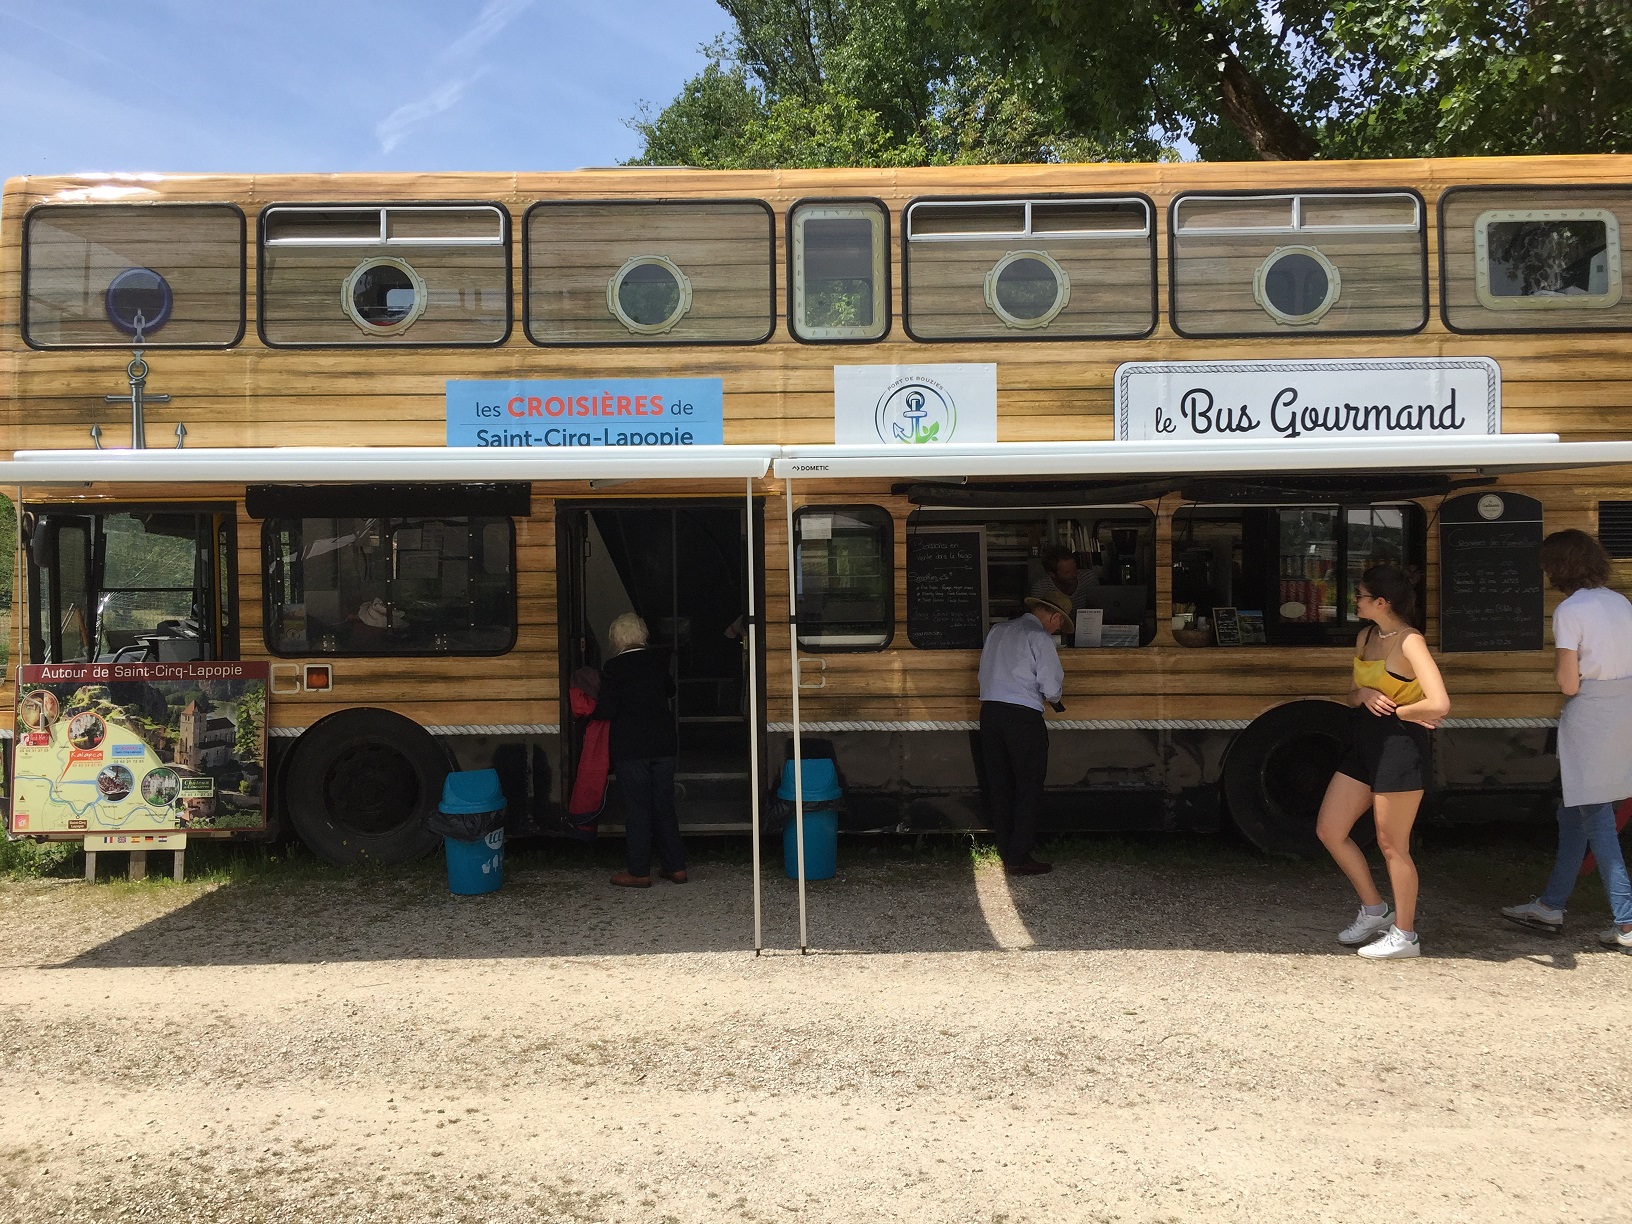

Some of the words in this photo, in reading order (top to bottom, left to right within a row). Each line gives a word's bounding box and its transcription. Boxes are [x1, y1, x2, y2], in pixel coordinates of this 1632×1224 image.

[887, 378, 904, 391] PORT
[916, 376, 944, 391] BOUZIES
[476, 401, 501, 417] les
[507, 391, 664, 417] CROISIÈRES
[670, 400, 694, 416] de
[1154, 407, 1177, 433] le
[1180, 388, 1261, 433] Bus
[1270, 387, 1466, 439] Gourmand
[41, 667, 88, 679] Autour
[93, 666, 110, 678] de
[114, 664, 243, 677] Saint-Cirq-Lapopie
[489, 831, 502, 844] ICE
